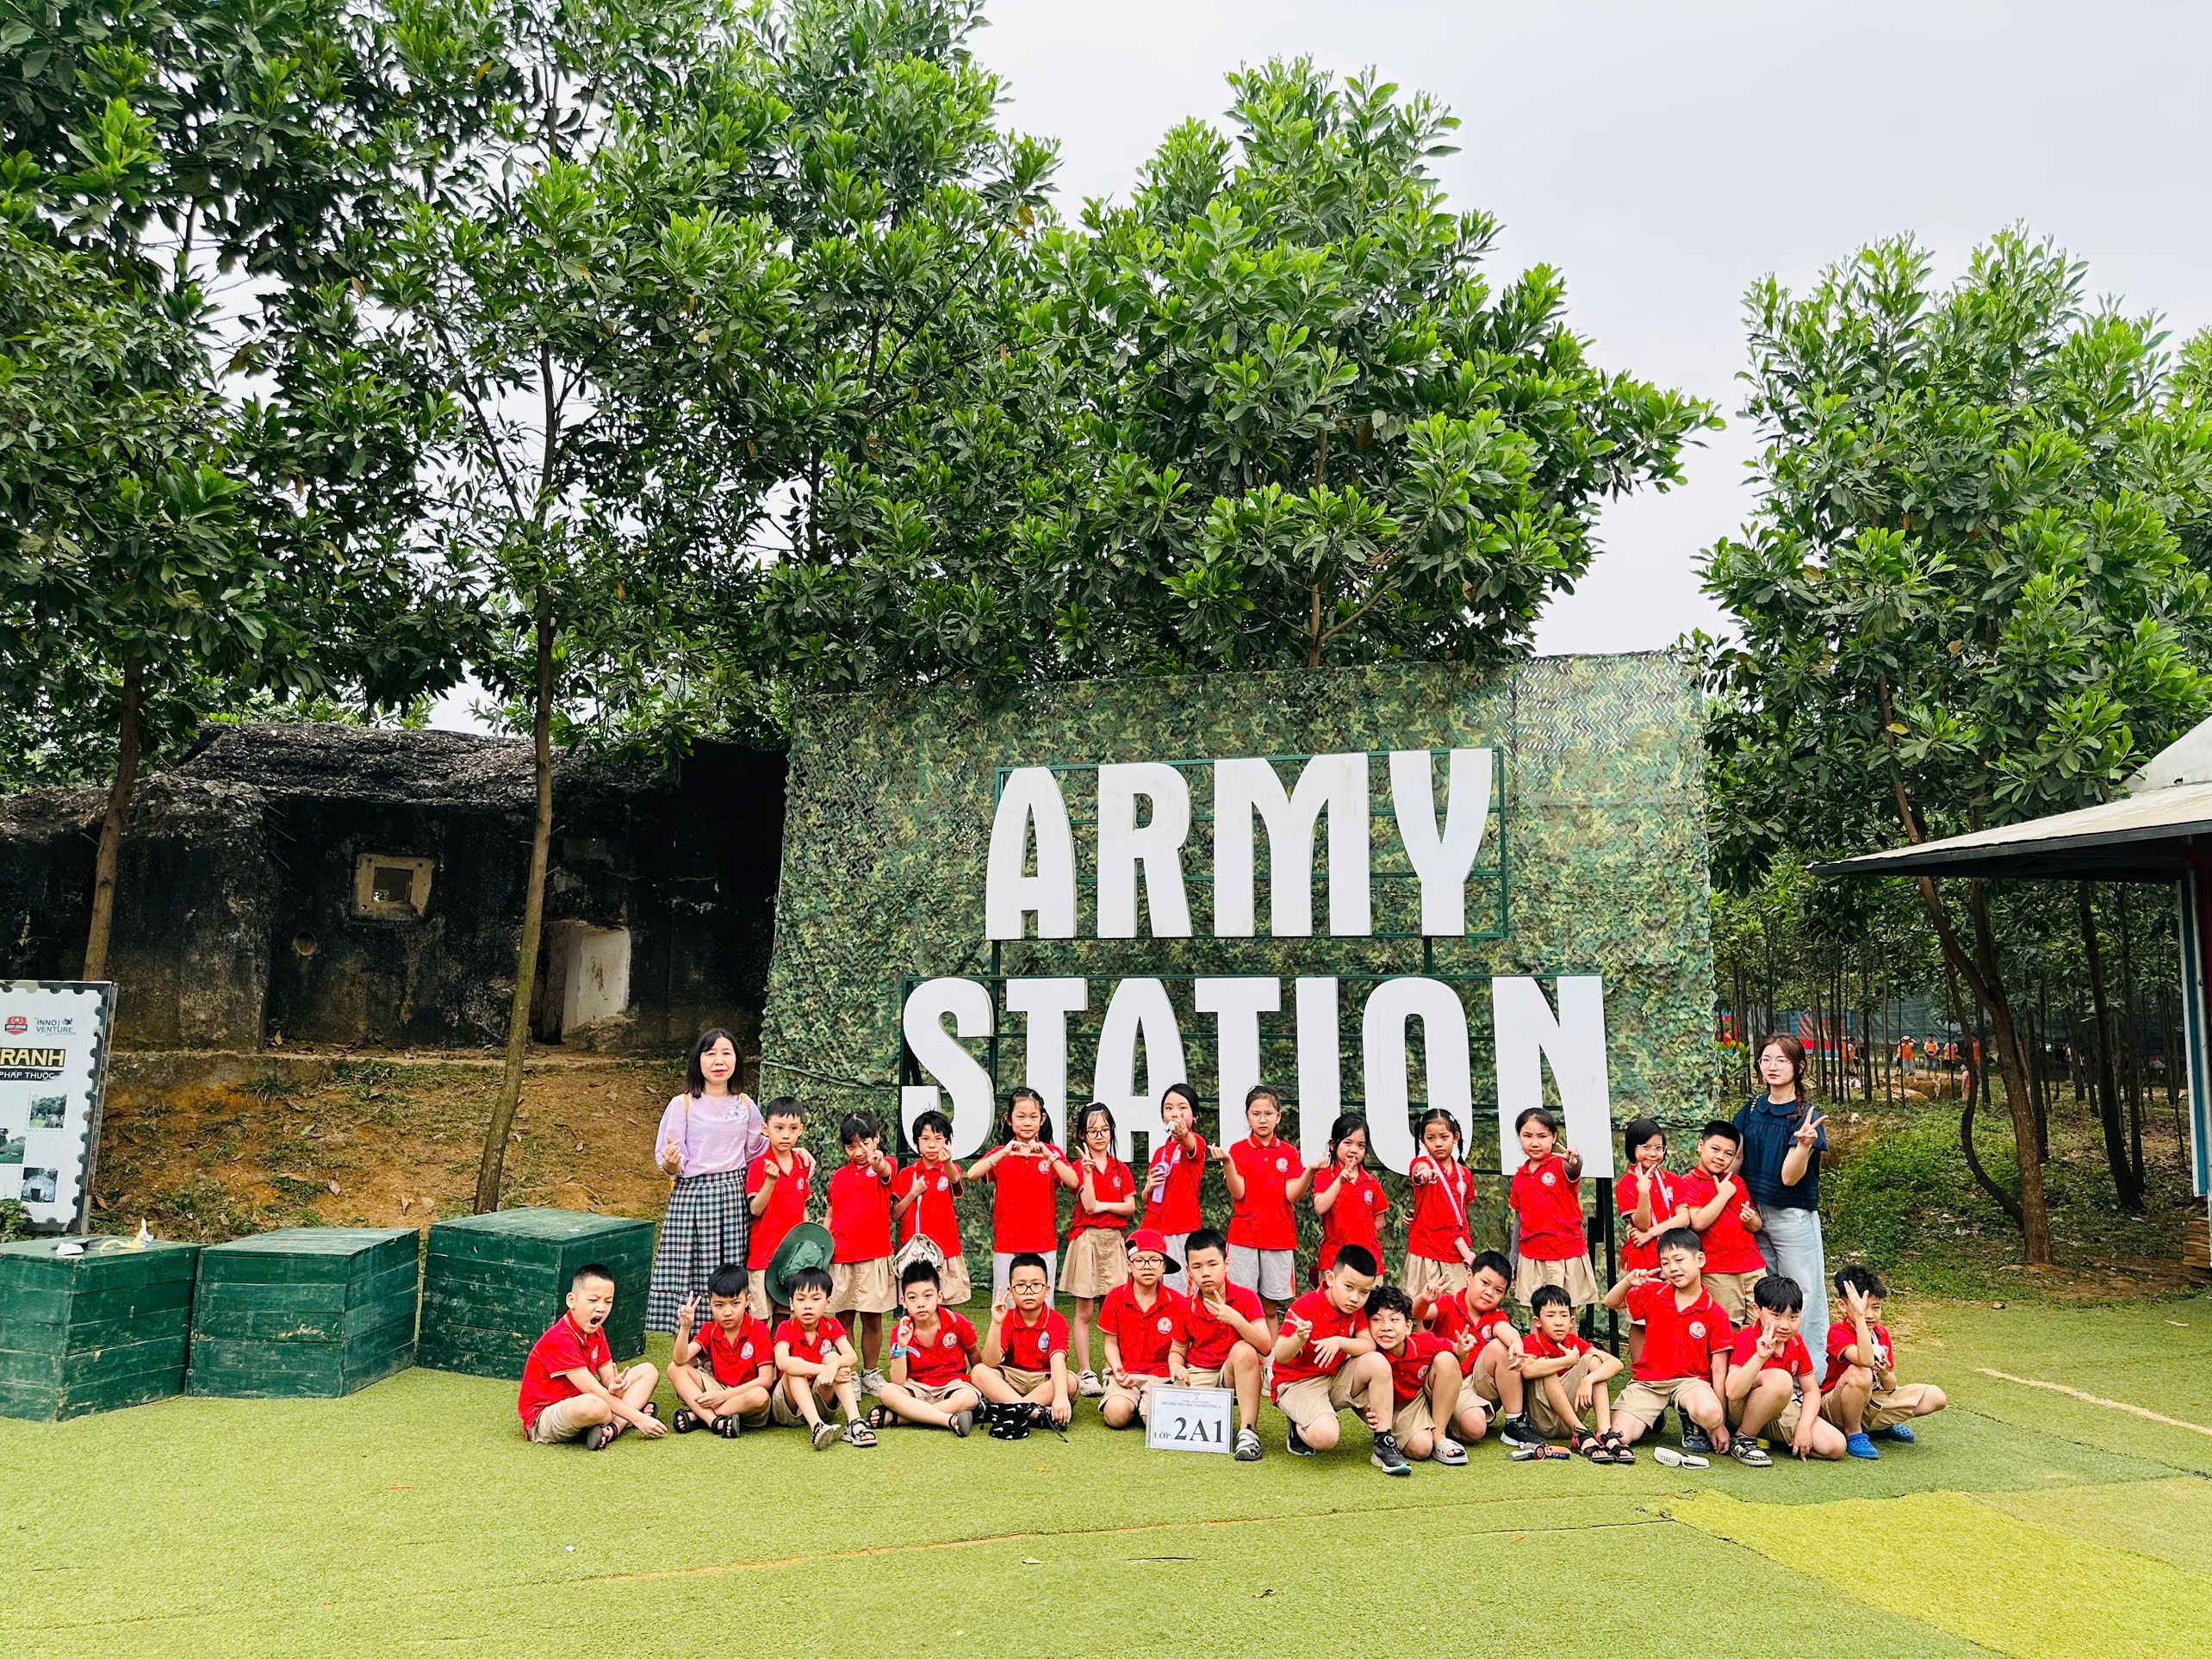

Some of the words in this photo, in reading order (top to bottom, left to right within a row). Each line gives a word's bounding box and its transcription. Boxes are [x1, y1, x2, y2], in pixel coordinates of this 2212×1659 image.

[985, 748, 1493, 940] ARMY
[0, 1048, 65, 1066] RANH
[901, 976, 1615, 1177] STATION
[1174, 1417, 1225, 1443] 2A1
